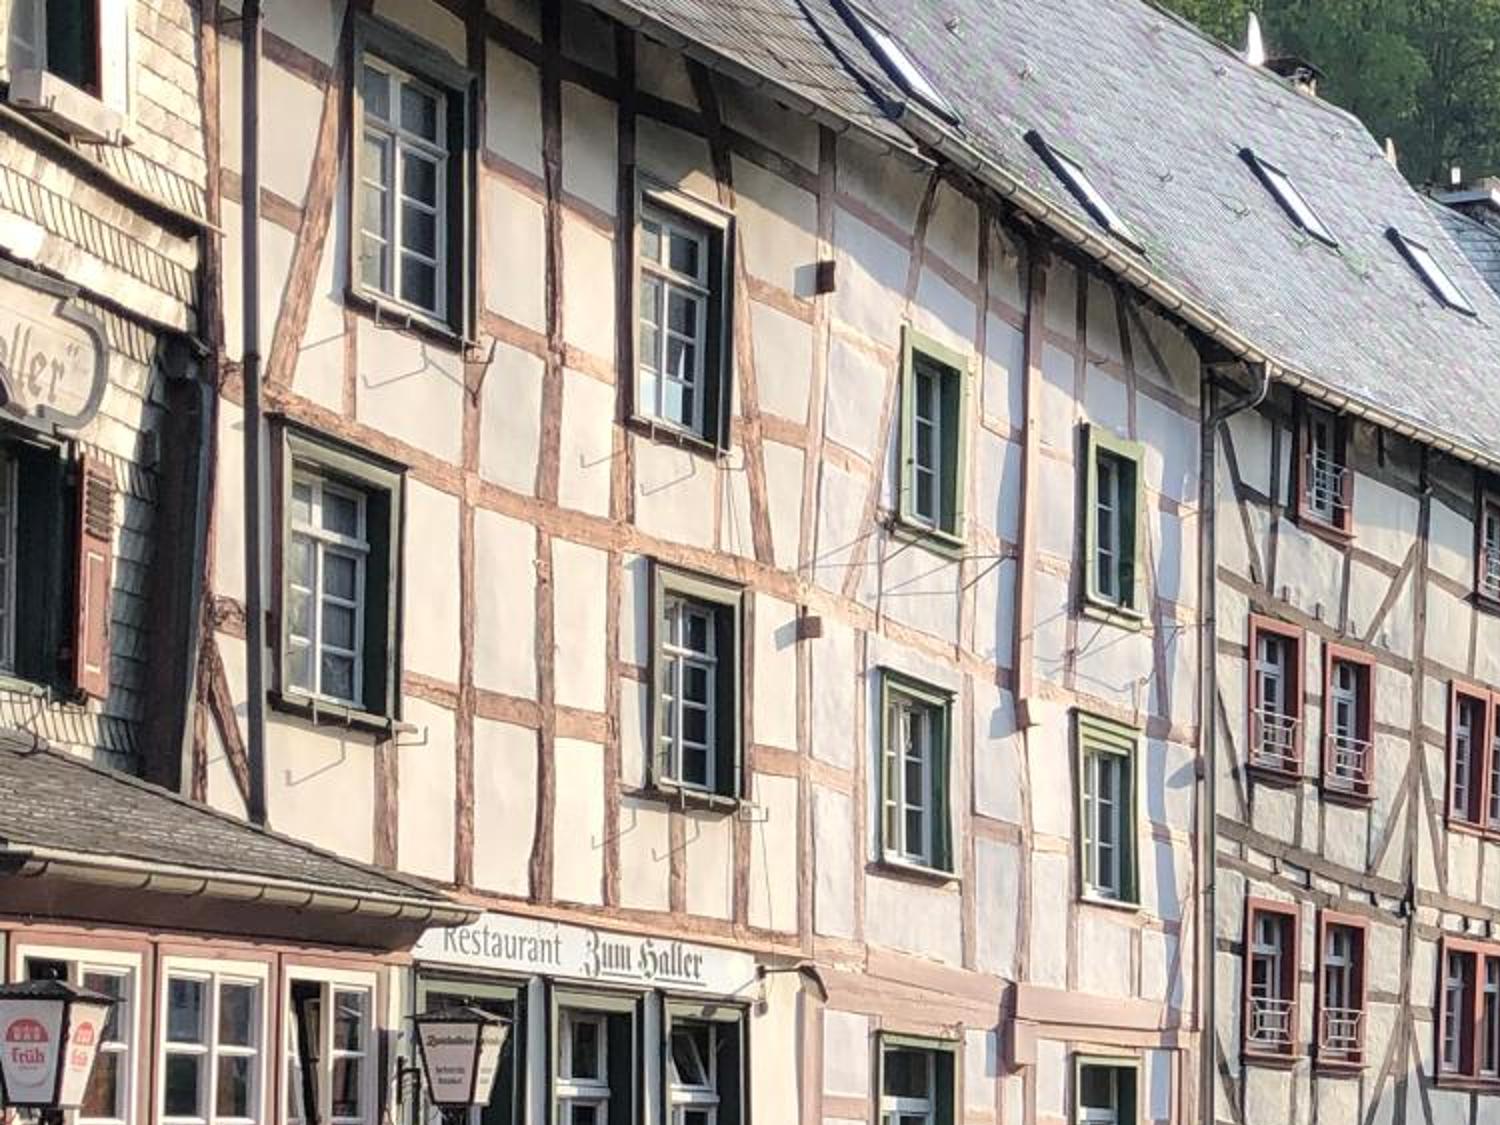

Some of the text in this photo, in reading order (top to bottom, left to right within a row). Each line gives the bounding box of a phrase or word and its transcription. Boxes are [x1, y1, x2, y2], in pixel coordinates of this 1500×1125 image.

[444, 925, 704, 979] Restaurant Zum Haller
